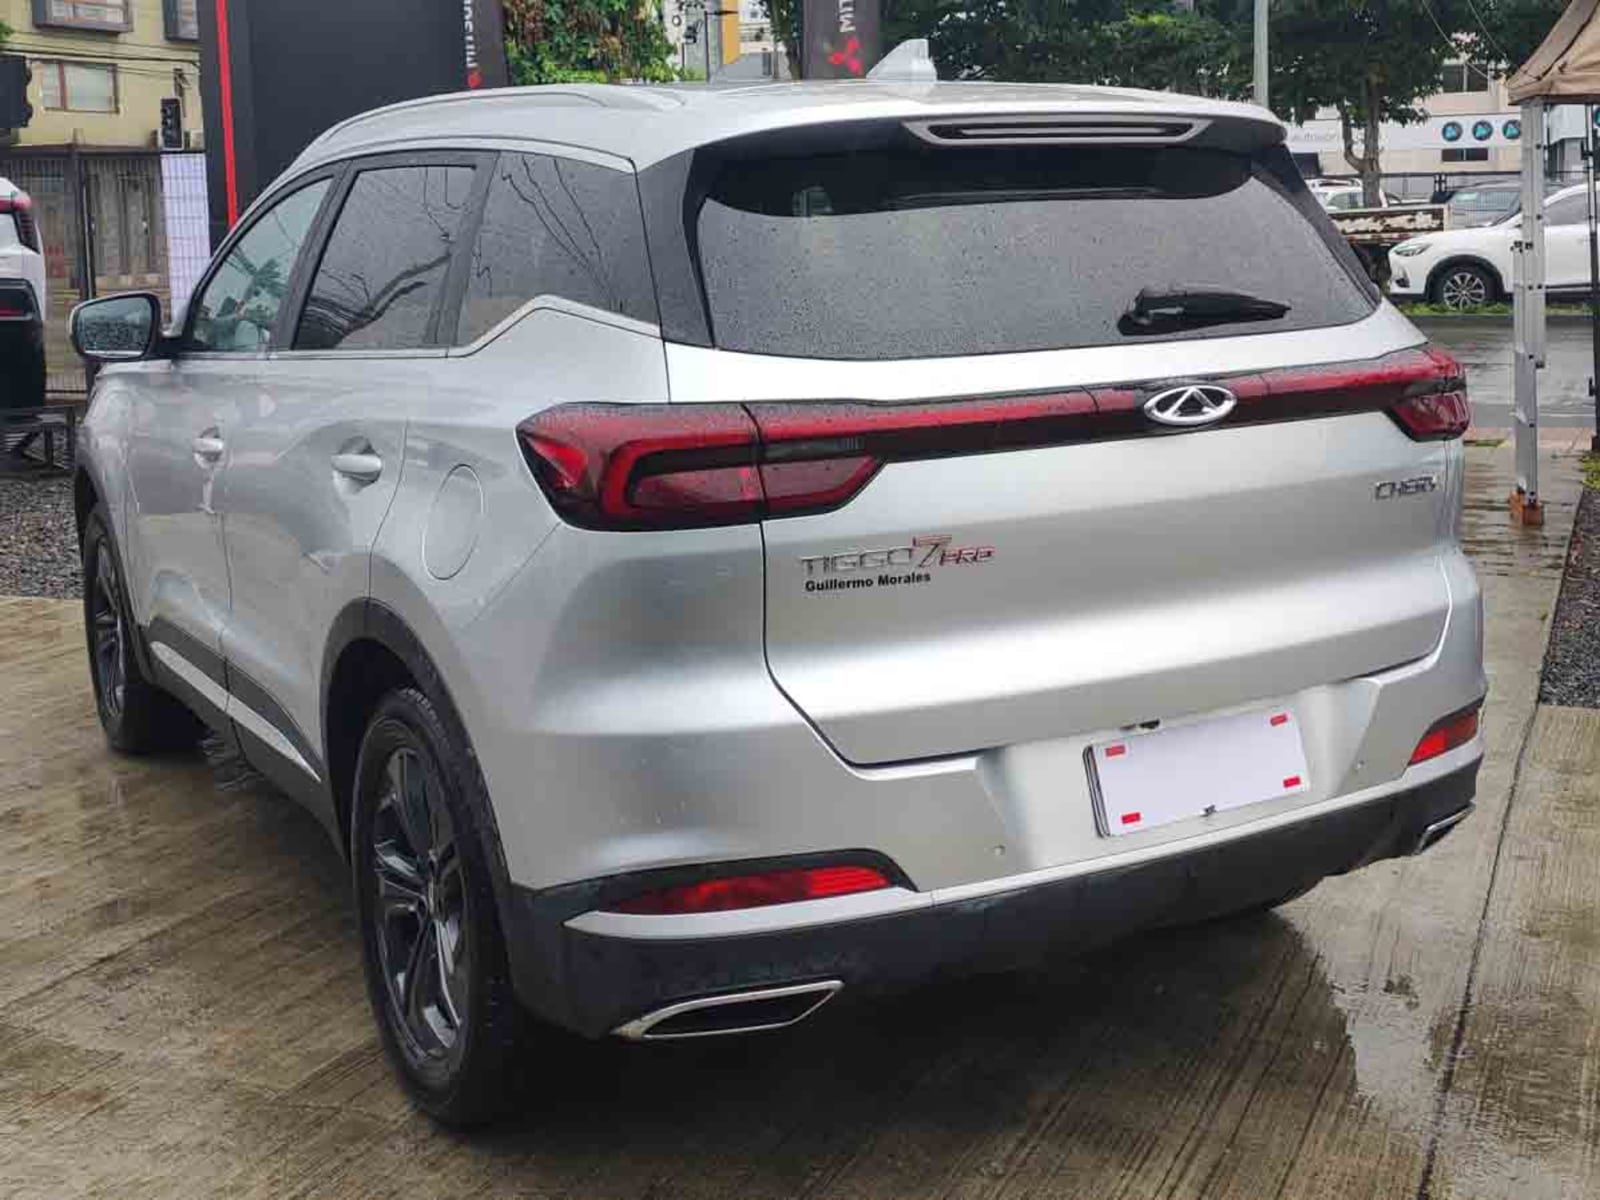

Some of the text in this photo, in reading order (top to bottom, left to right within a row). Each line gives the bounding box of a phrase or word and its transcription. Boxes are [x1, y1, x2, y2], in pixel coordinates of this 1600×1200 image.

[799, 547, 913, 576] TIGGO
[911, 535, 952, 568] 7
[804, 572, 932, 593] Guillermo Morales
